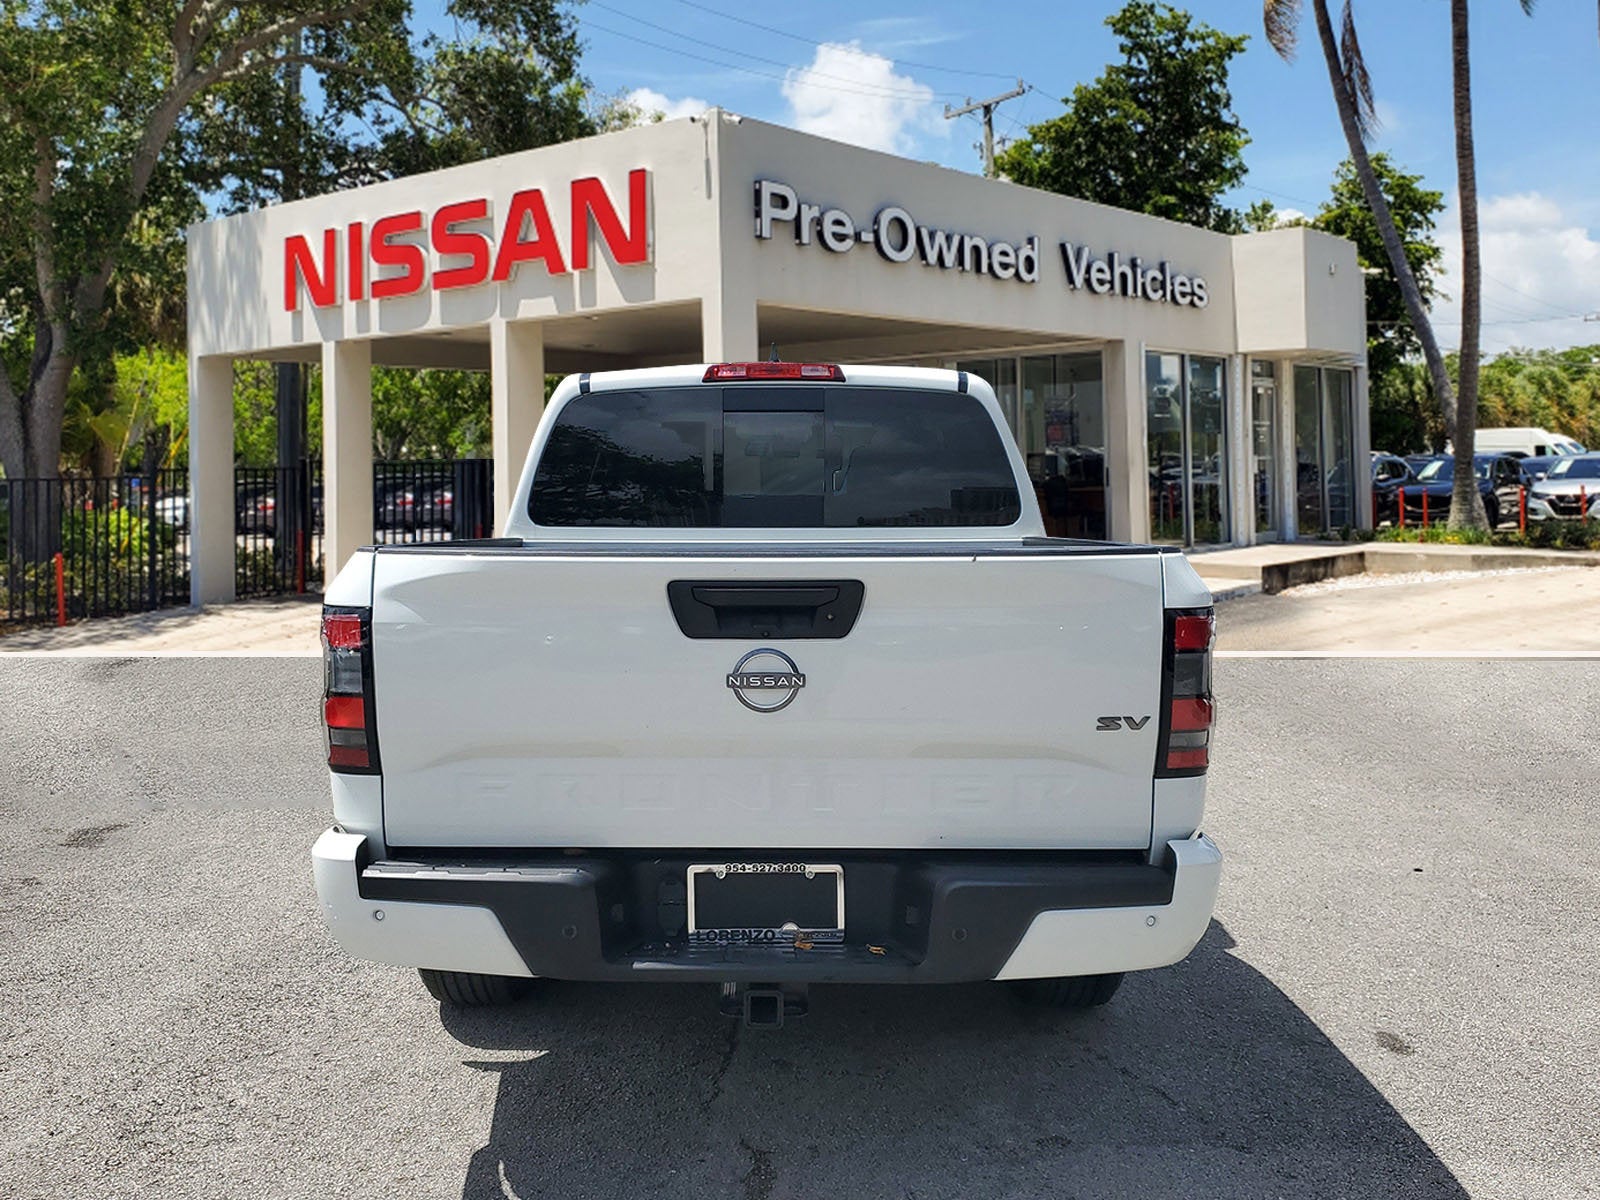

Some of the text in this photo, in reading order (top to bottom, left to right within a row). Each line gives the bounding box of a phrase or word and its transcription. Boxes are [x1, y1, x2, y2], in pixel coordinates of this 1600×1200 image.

[285, 168, 647, 312] NISSAN
[754, 180, 1209, 309] Pre-Owned Vehicles
[727, 675, 804, 687] NISSAN
[1096, 716, 1151, 731] SV
[455, 772, 1082, 815] FRONTIER
[697, 929, 776, 942] LORENZO
